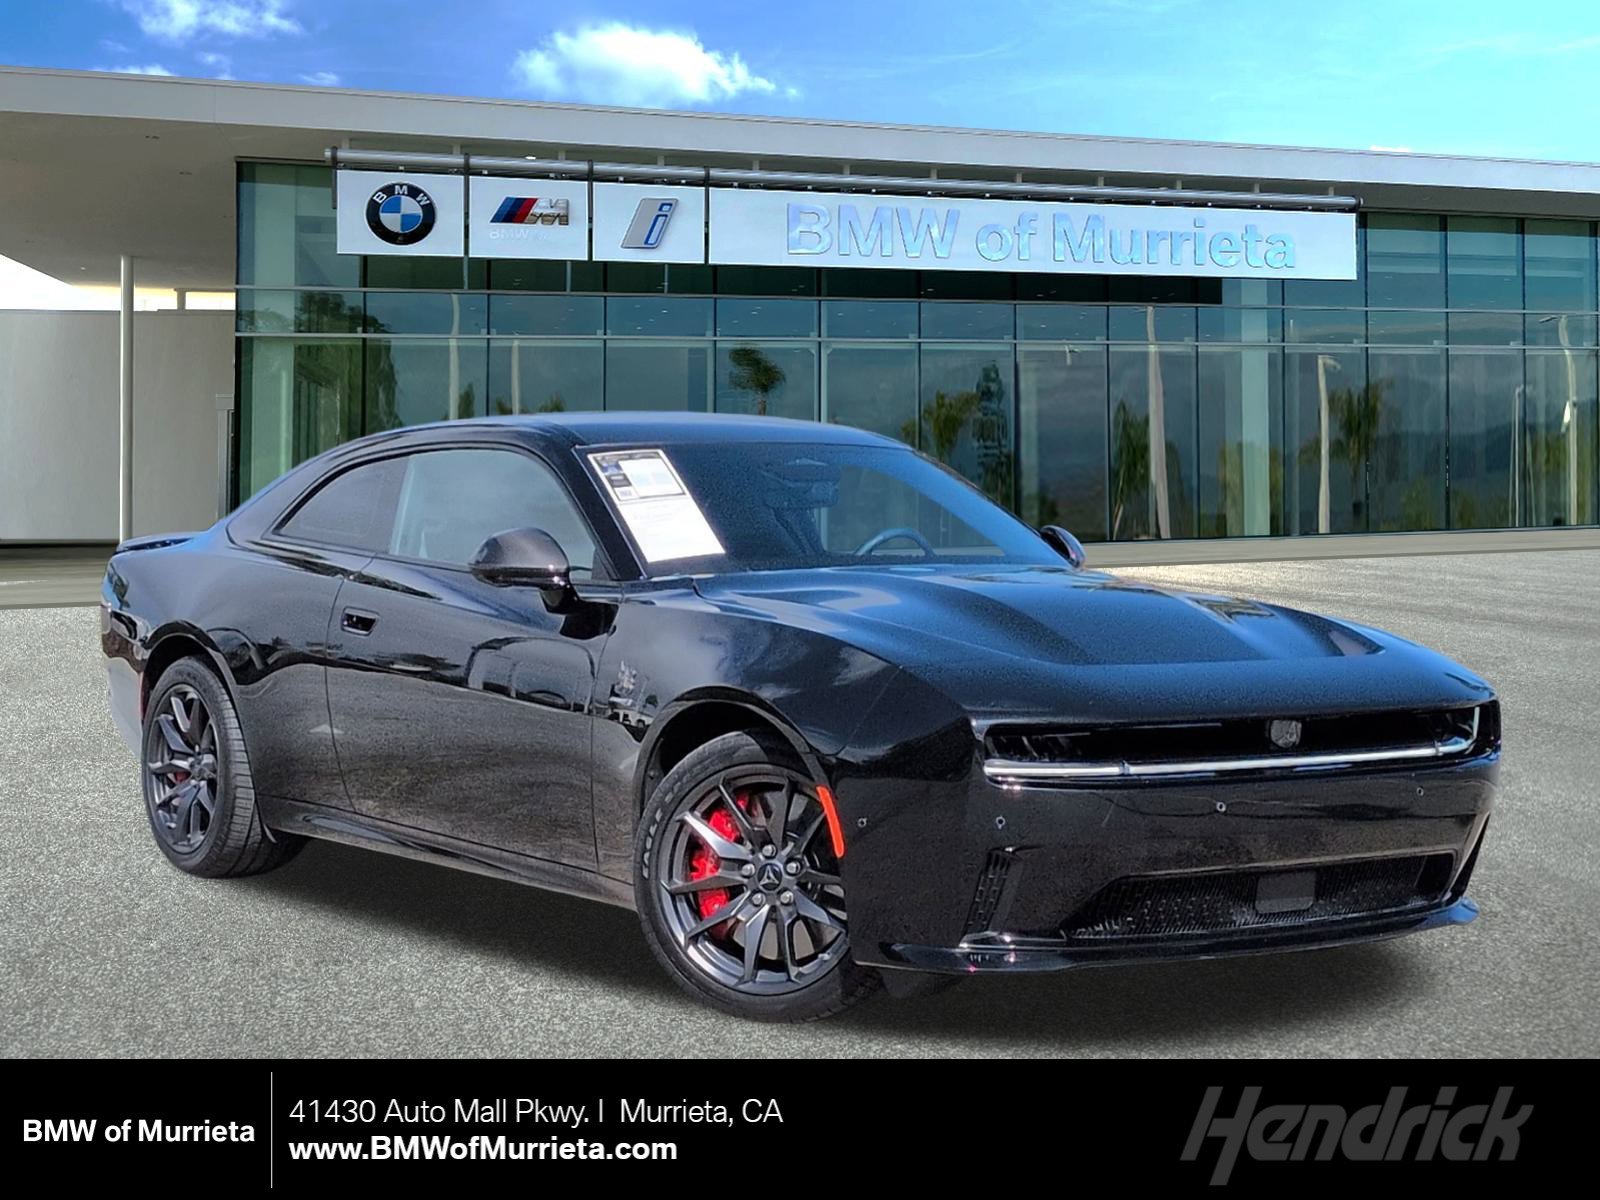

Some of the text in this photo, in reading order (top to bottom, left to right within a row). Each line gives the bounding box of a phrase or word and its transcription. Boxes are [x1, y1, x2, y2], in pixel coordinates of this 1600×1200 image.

[373, 185, 430, 206] BMW
[786, 202, 1296, 269] BMW of Murrieta
